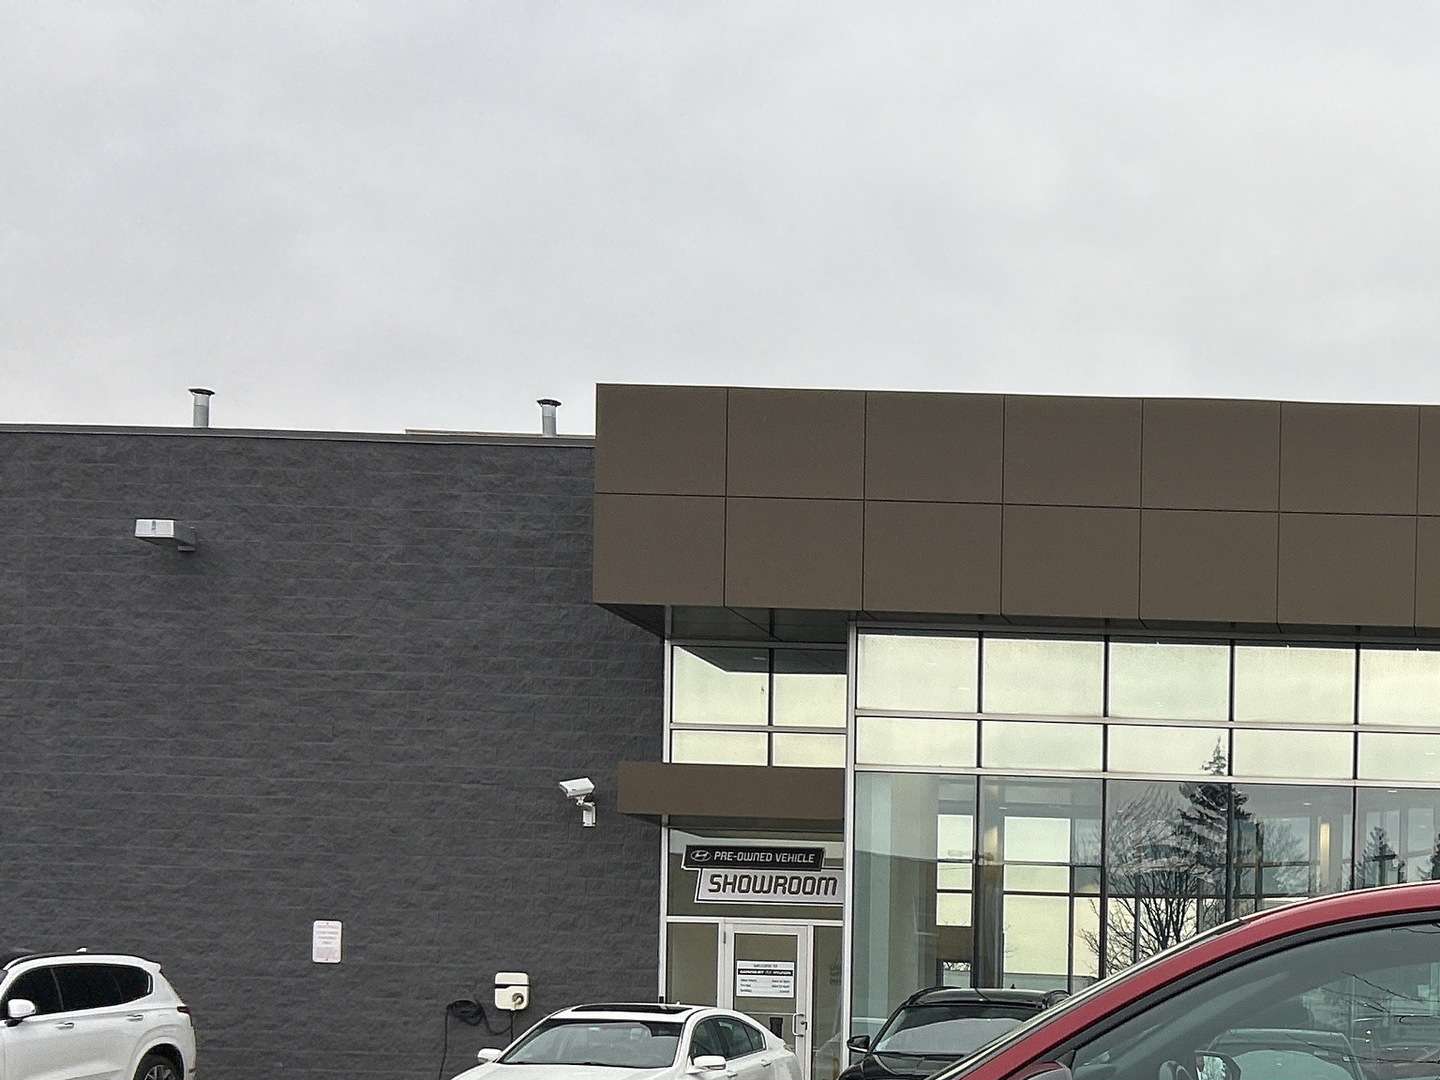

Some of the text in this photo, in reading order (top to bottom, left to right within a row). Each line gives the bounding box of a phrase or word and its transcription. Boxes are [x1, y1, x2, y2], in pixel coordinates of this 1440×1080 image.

[714, 851, 816, 863] PRE-OWNED VEHICLE
[708, 873, 838, 896] SHOWROOM
